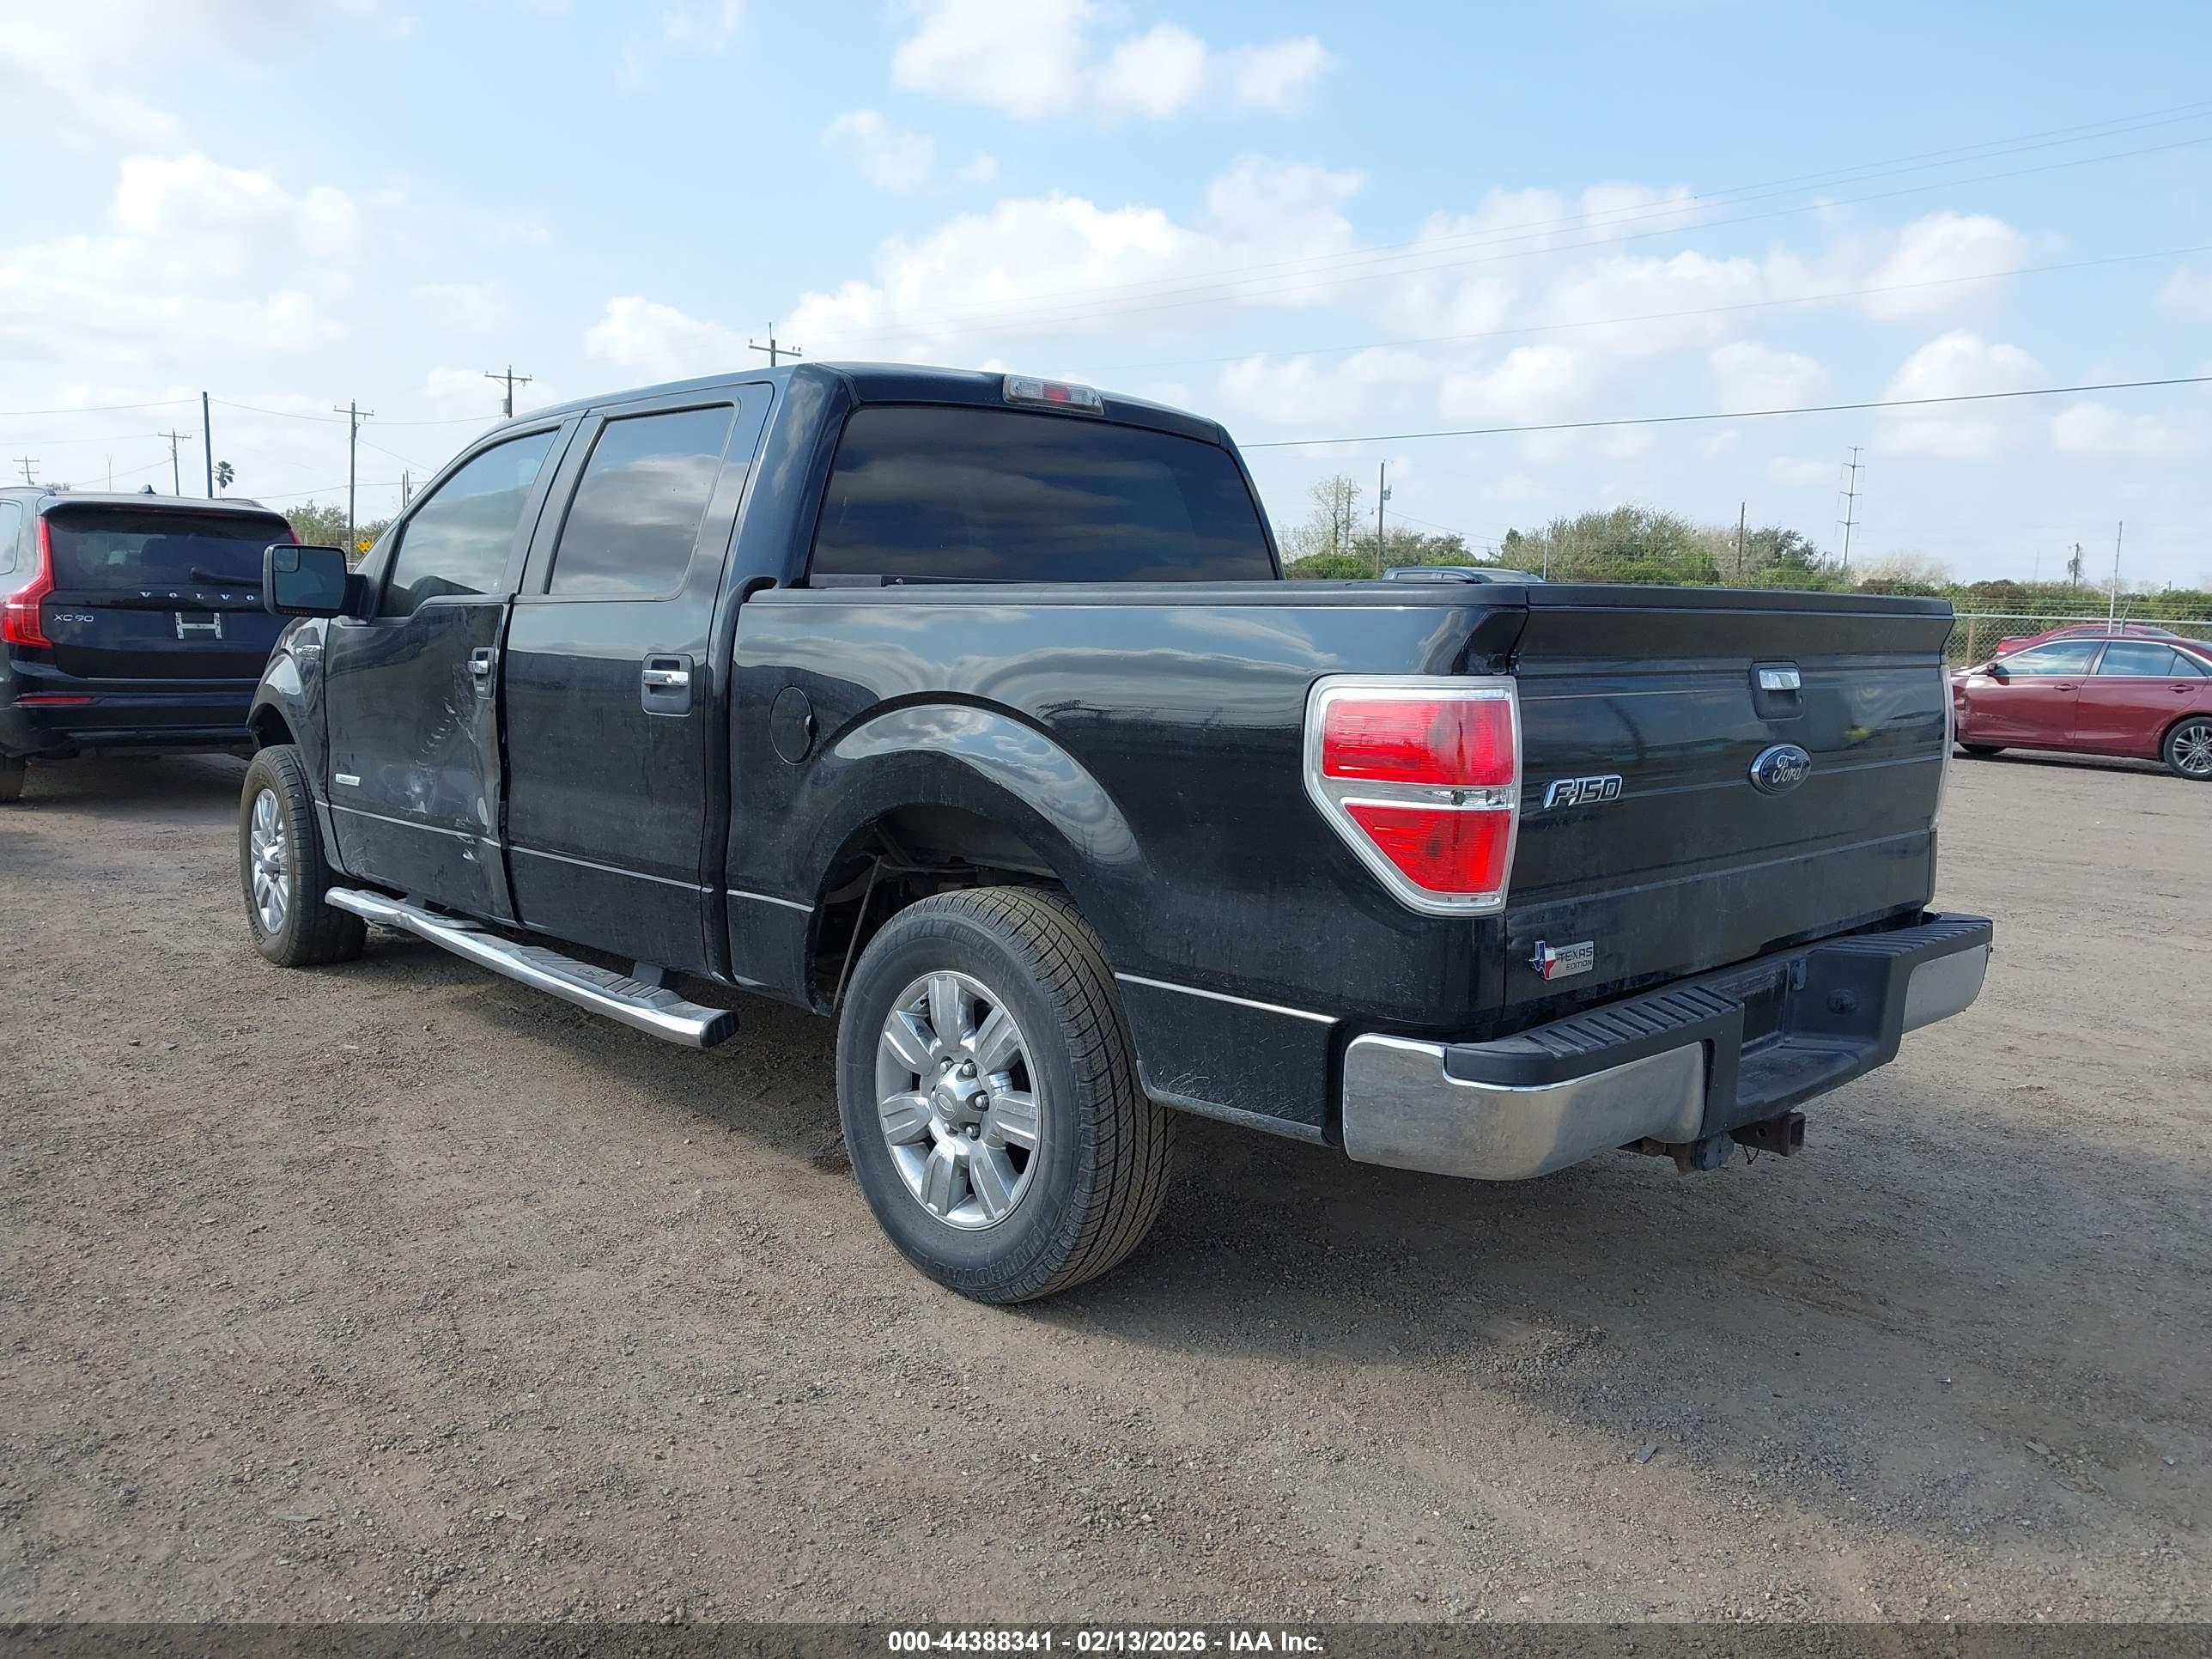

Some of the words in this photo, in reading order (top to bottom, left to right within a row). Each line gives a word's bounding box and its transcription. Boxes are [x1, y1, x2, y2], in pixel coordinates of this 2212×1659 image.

[139, 591, 255, 602] VOLVO
[53, 612, 95, 623] XC90
[1771, 756, 1804, 785] Ford
[1559, 946, 1594, 963] TEXAS
[1565, 959, 1593, 971] EDITION
[933, 1225, 1047, 1285] UNIROYAL
